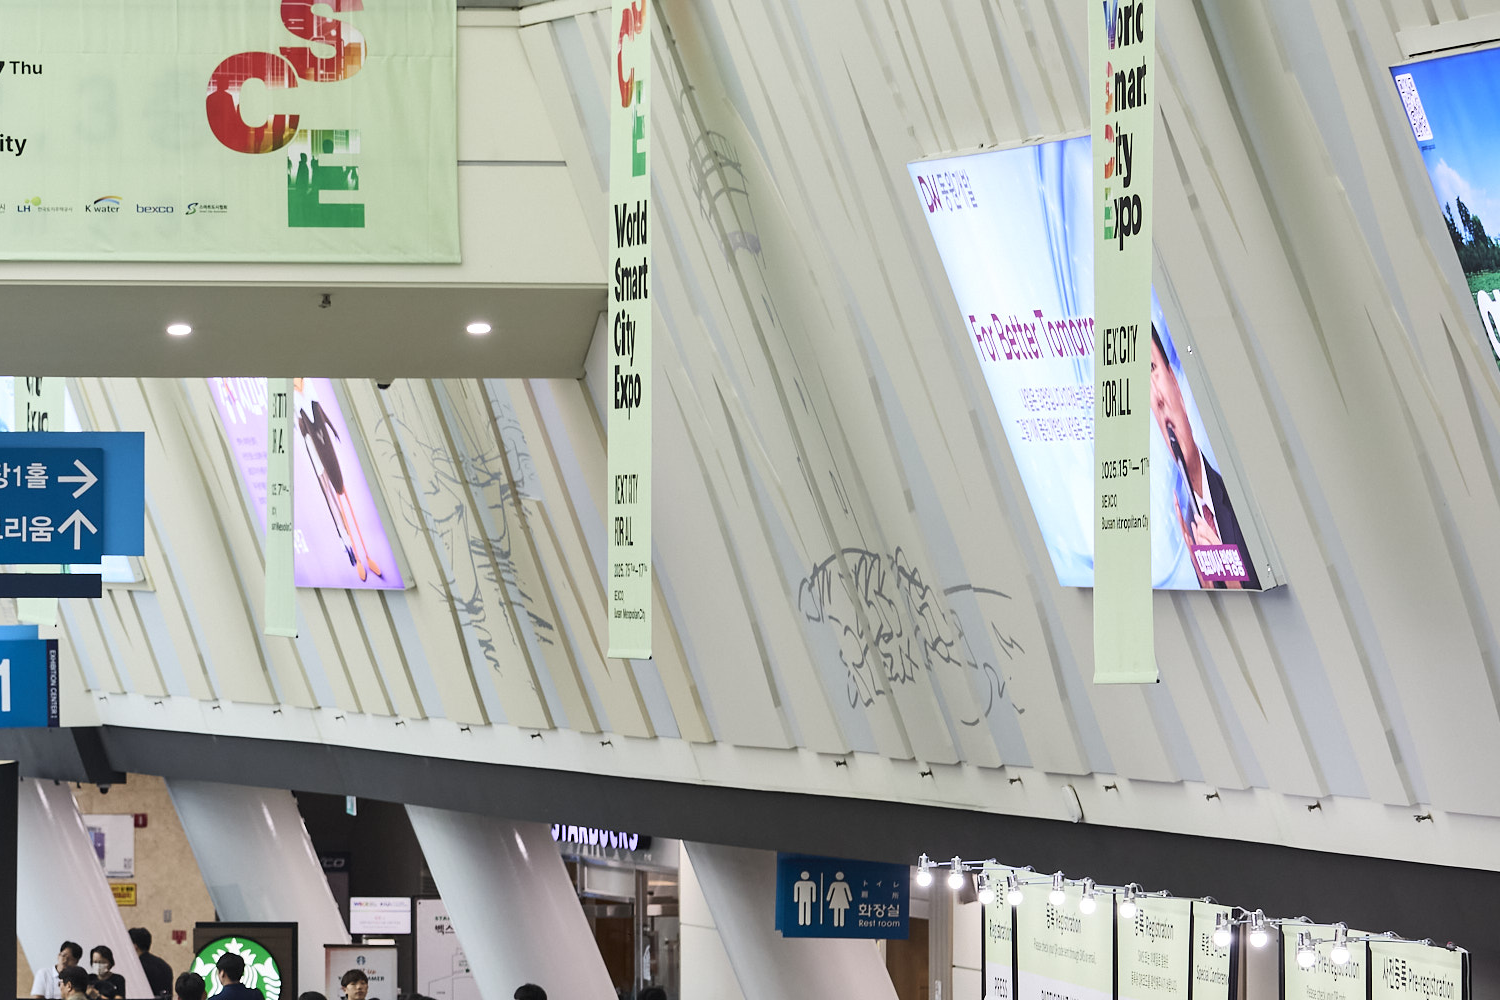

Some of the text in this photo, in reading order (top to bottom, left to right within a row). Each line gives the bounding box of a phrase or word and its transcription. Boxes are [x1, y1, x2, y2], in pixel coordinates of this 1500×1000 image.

[614, 199, 647, 248] World
[614, 257, 648, 302] Smart
[614, 309, 636, 367] City
[968, 313, 1045, 362] For Better
[614, 365, 642, 420] Expo
[49, 650, 58, 714] EXHIBITION CENTER
[858, 903, 900, 918] 화장실
[858, 919, 876, 927] Rest
